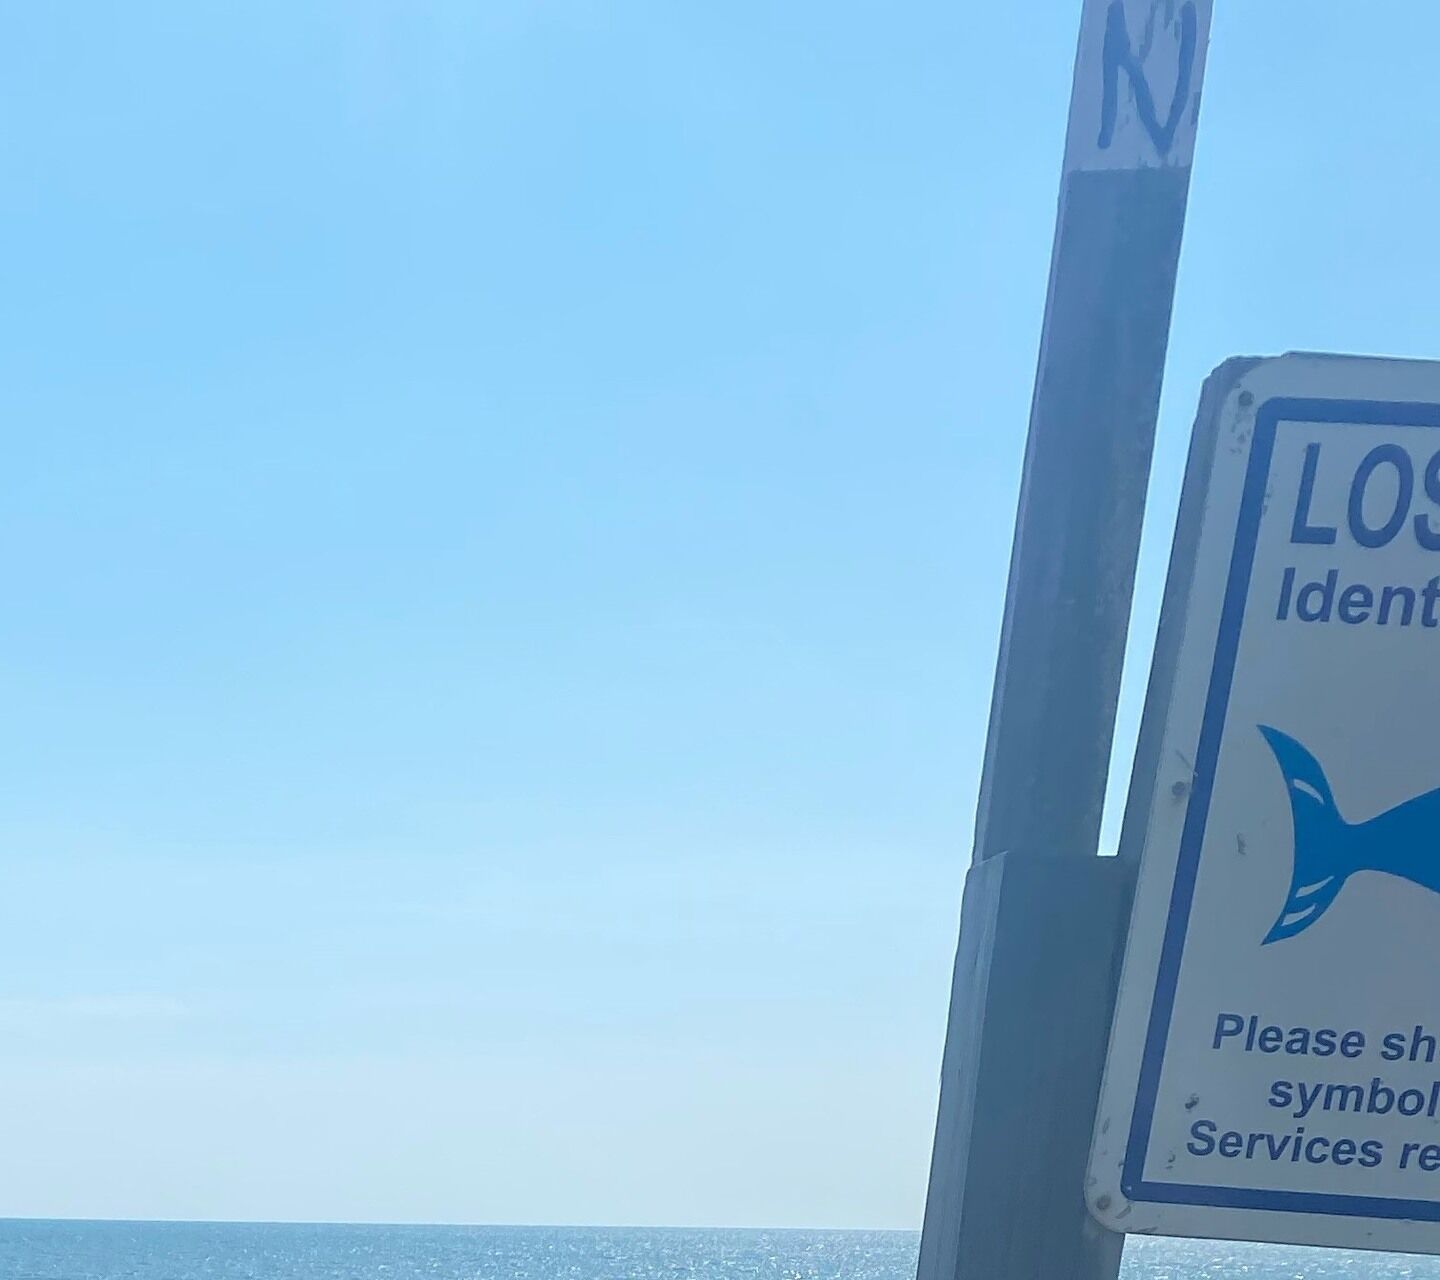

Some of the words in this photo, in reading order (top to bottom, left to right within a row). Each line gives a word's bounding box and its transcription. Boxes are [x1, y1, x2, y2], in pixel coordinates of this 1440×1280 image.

[1276, 567, 1440, 627] Ident
[1212, 1012, 1365, 1059] Please
[1268, 1077, 1440, 1119] symbol
[1186, 1119, 1384, 1168] Services
[1398, 1142, 1440, 1172] re
